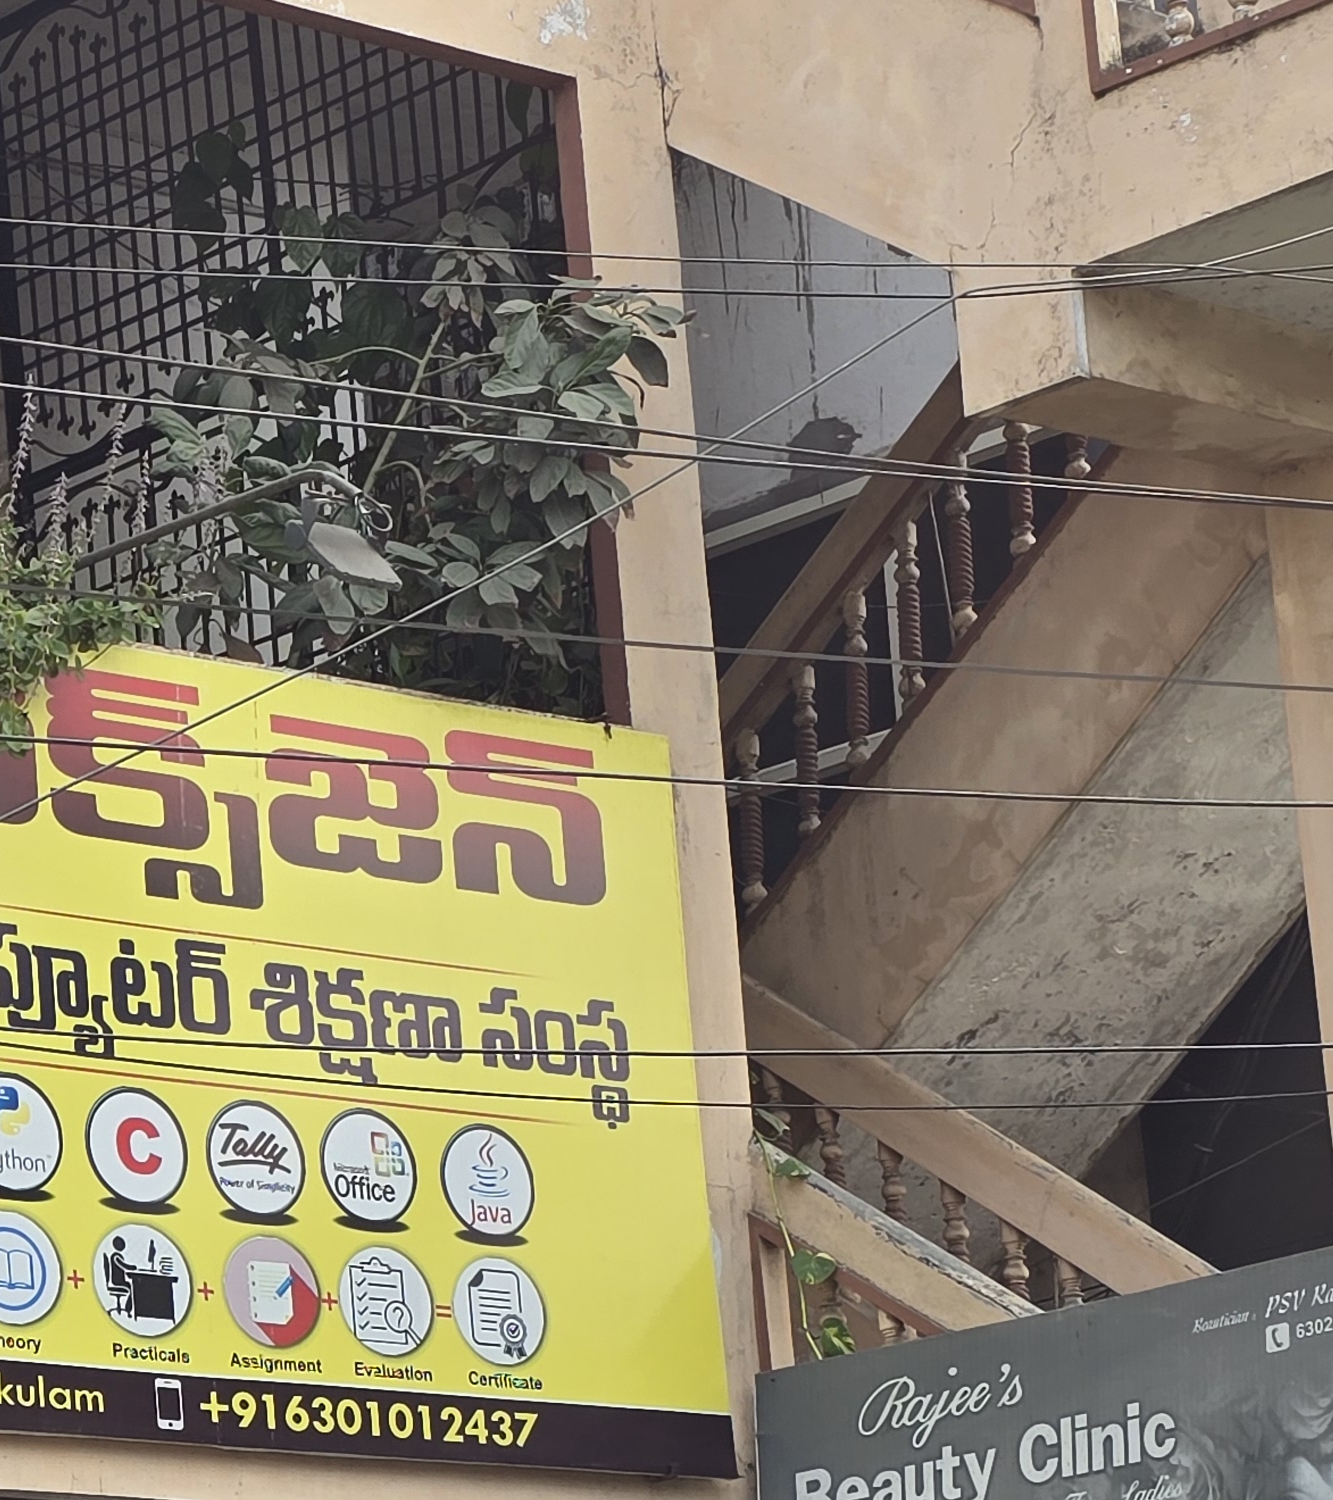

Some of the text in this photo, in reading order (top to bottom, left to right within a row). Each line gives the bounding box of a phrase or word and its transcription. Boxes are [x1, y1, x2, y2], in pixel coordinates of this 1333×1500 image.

[218, 1122, 291, 1174] Tally
[334, 1174, 396, 1203] Office
[470, 1201, 513, 1227] Java
[112, 1343, 191, 1365] Practicals
[230, 1353, 323, 1375] Assignment
[354, 1361, 433, 1383] Evaluation
[468, 1371, 544, 1391] Certificate
[200, 1391, 538, 1448] +916301012437
[1019, 1402, 1176, 1484] Clinic
